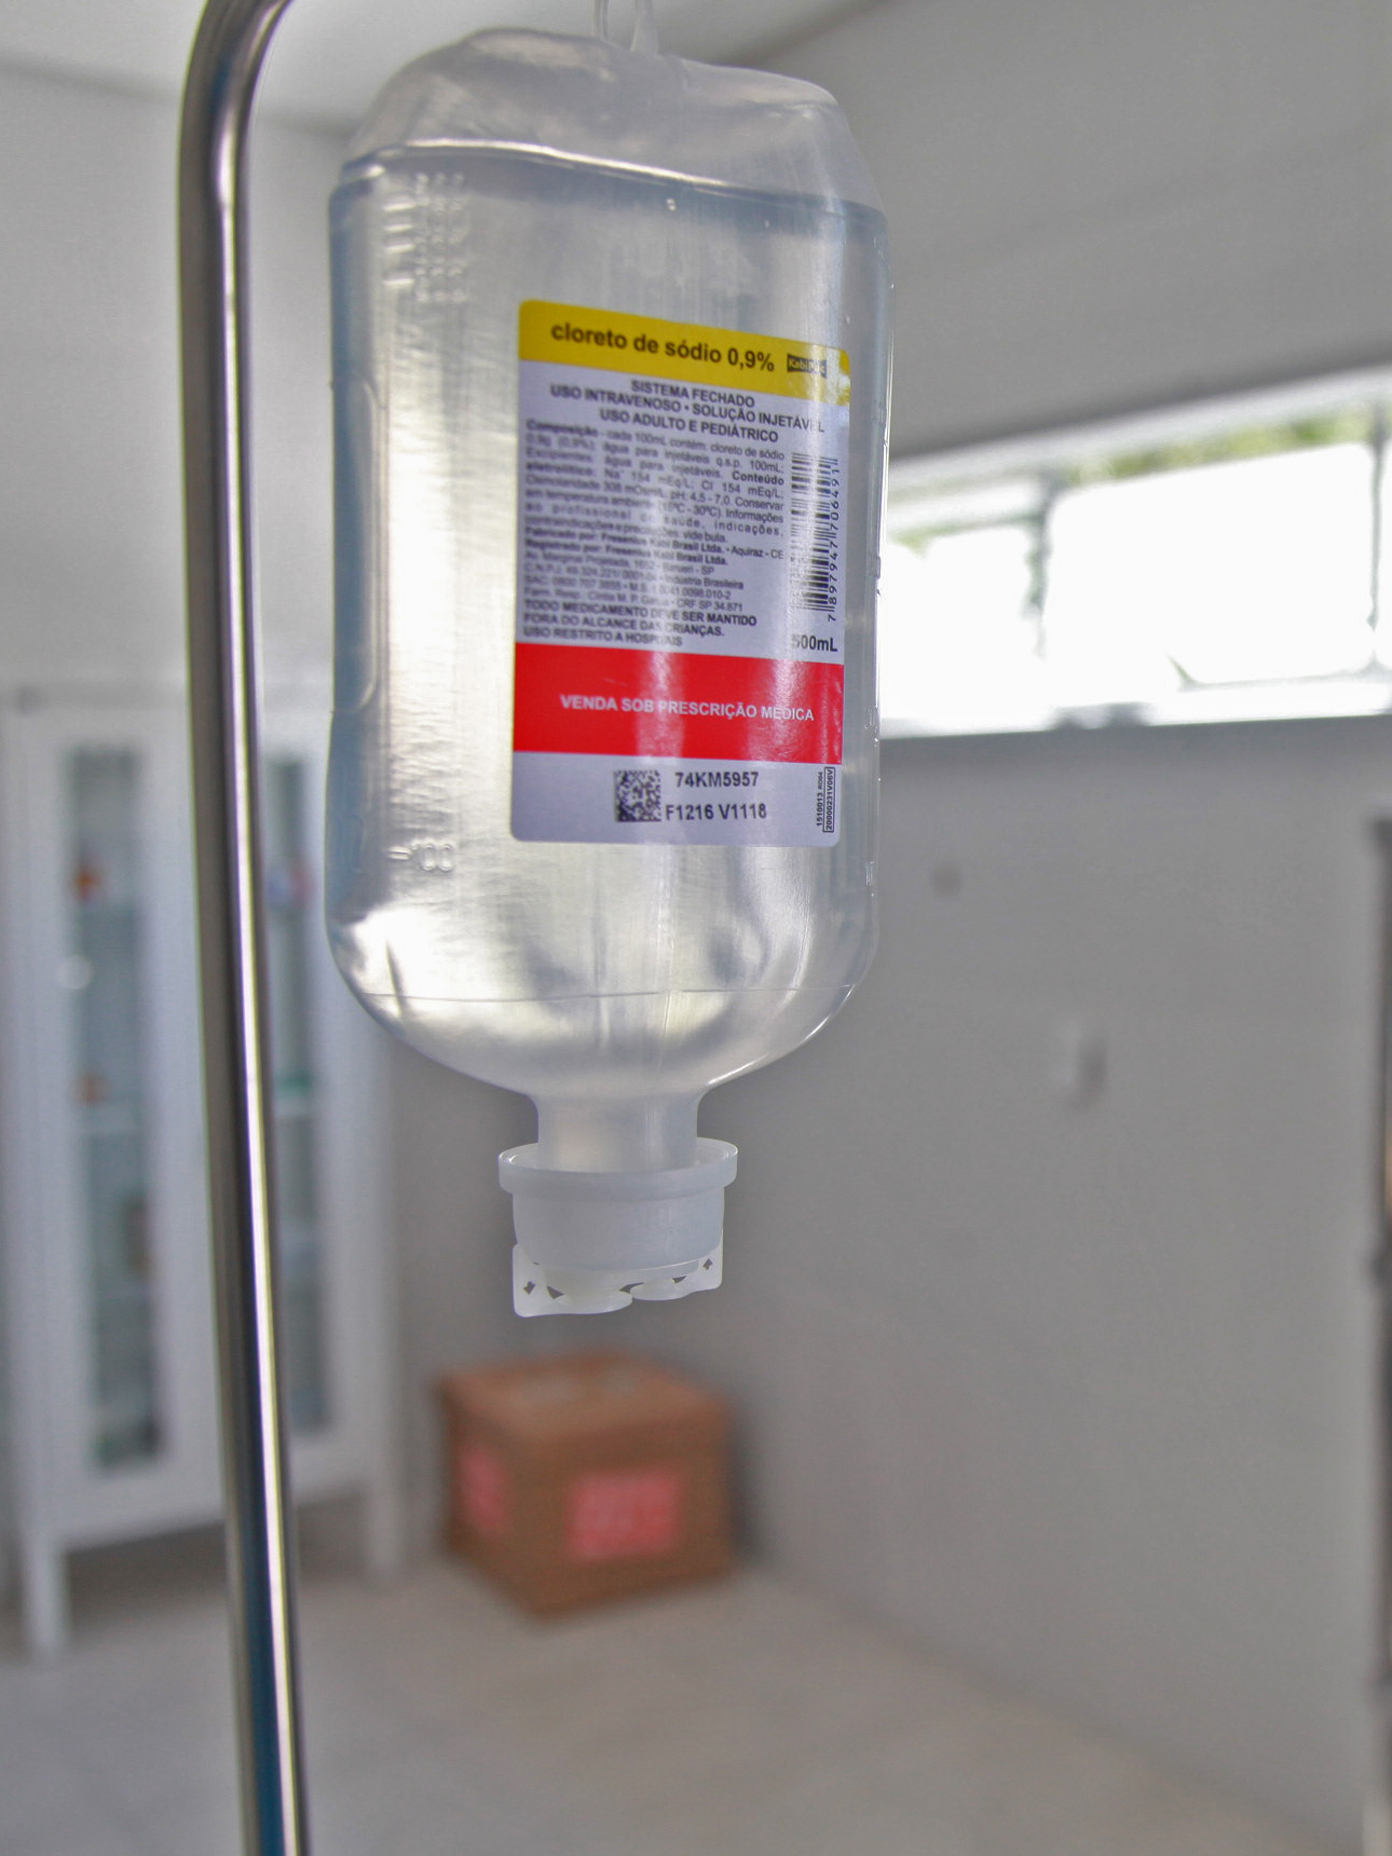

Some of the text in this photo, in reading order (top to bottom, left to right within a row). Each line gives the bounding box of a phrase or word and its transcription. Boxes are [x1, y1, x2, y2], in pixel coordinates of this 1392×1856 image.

[551, 323, 774, 372] cloreto de sódio 0,9%
[631, 379, 755, 408] SISTEMA FECHADO
[550, 384, 581, 399] USO
[584, 388, 681, 413] INTRAVENOSO
[692, 402, 756, 423] SOLUÇÃO
[600, 407, 778, 443] USO ADULTO E PEDIÁTRICO
[710, 442, 743, 456] cloreto
[745, 447, 757, 457] de
[759, 448, 785, 461] sódio
[732, 470, 784, 486] Conteúdo
[722, 482, 741, 494] 154
[735, 496, 784, 512] Conservar
[725, 507, 784, 524] Informações
[672, 539, 699, 551] Brasil
[731, 545, 765, 559] Aquiraz
[676, 551, 703, 563] Brasil
[828, 541, 838, 605] 897947
[703, 577, 744, 590] Brasileira
[524, 611, 558, 623] FORA
[561, 614, 580, 625] DO
[582, 616, 638, 630] ALCANCE
[525, 598, 559, 611] TODO
[562, 601, 649, 618] MEDICAMENTO
[681, 612, 705, 623] SER
[706, 614, 758, 627] MANTIDO
[524, 626, 550, 637] USO
[553, 628, 613, 641] RESTRITO
[614, 631, 623, 642] A
[791, 633, 838, 653] 500mL
[560, 694, 618, 712] VENDA
[621, 698, 655, 713] SOB
[658, 699, 757, 720] PRESCRIÇÃO
[674, 770, 759, 788] 74KM5957
[665, 802, 767, 820] F1216 V1118
